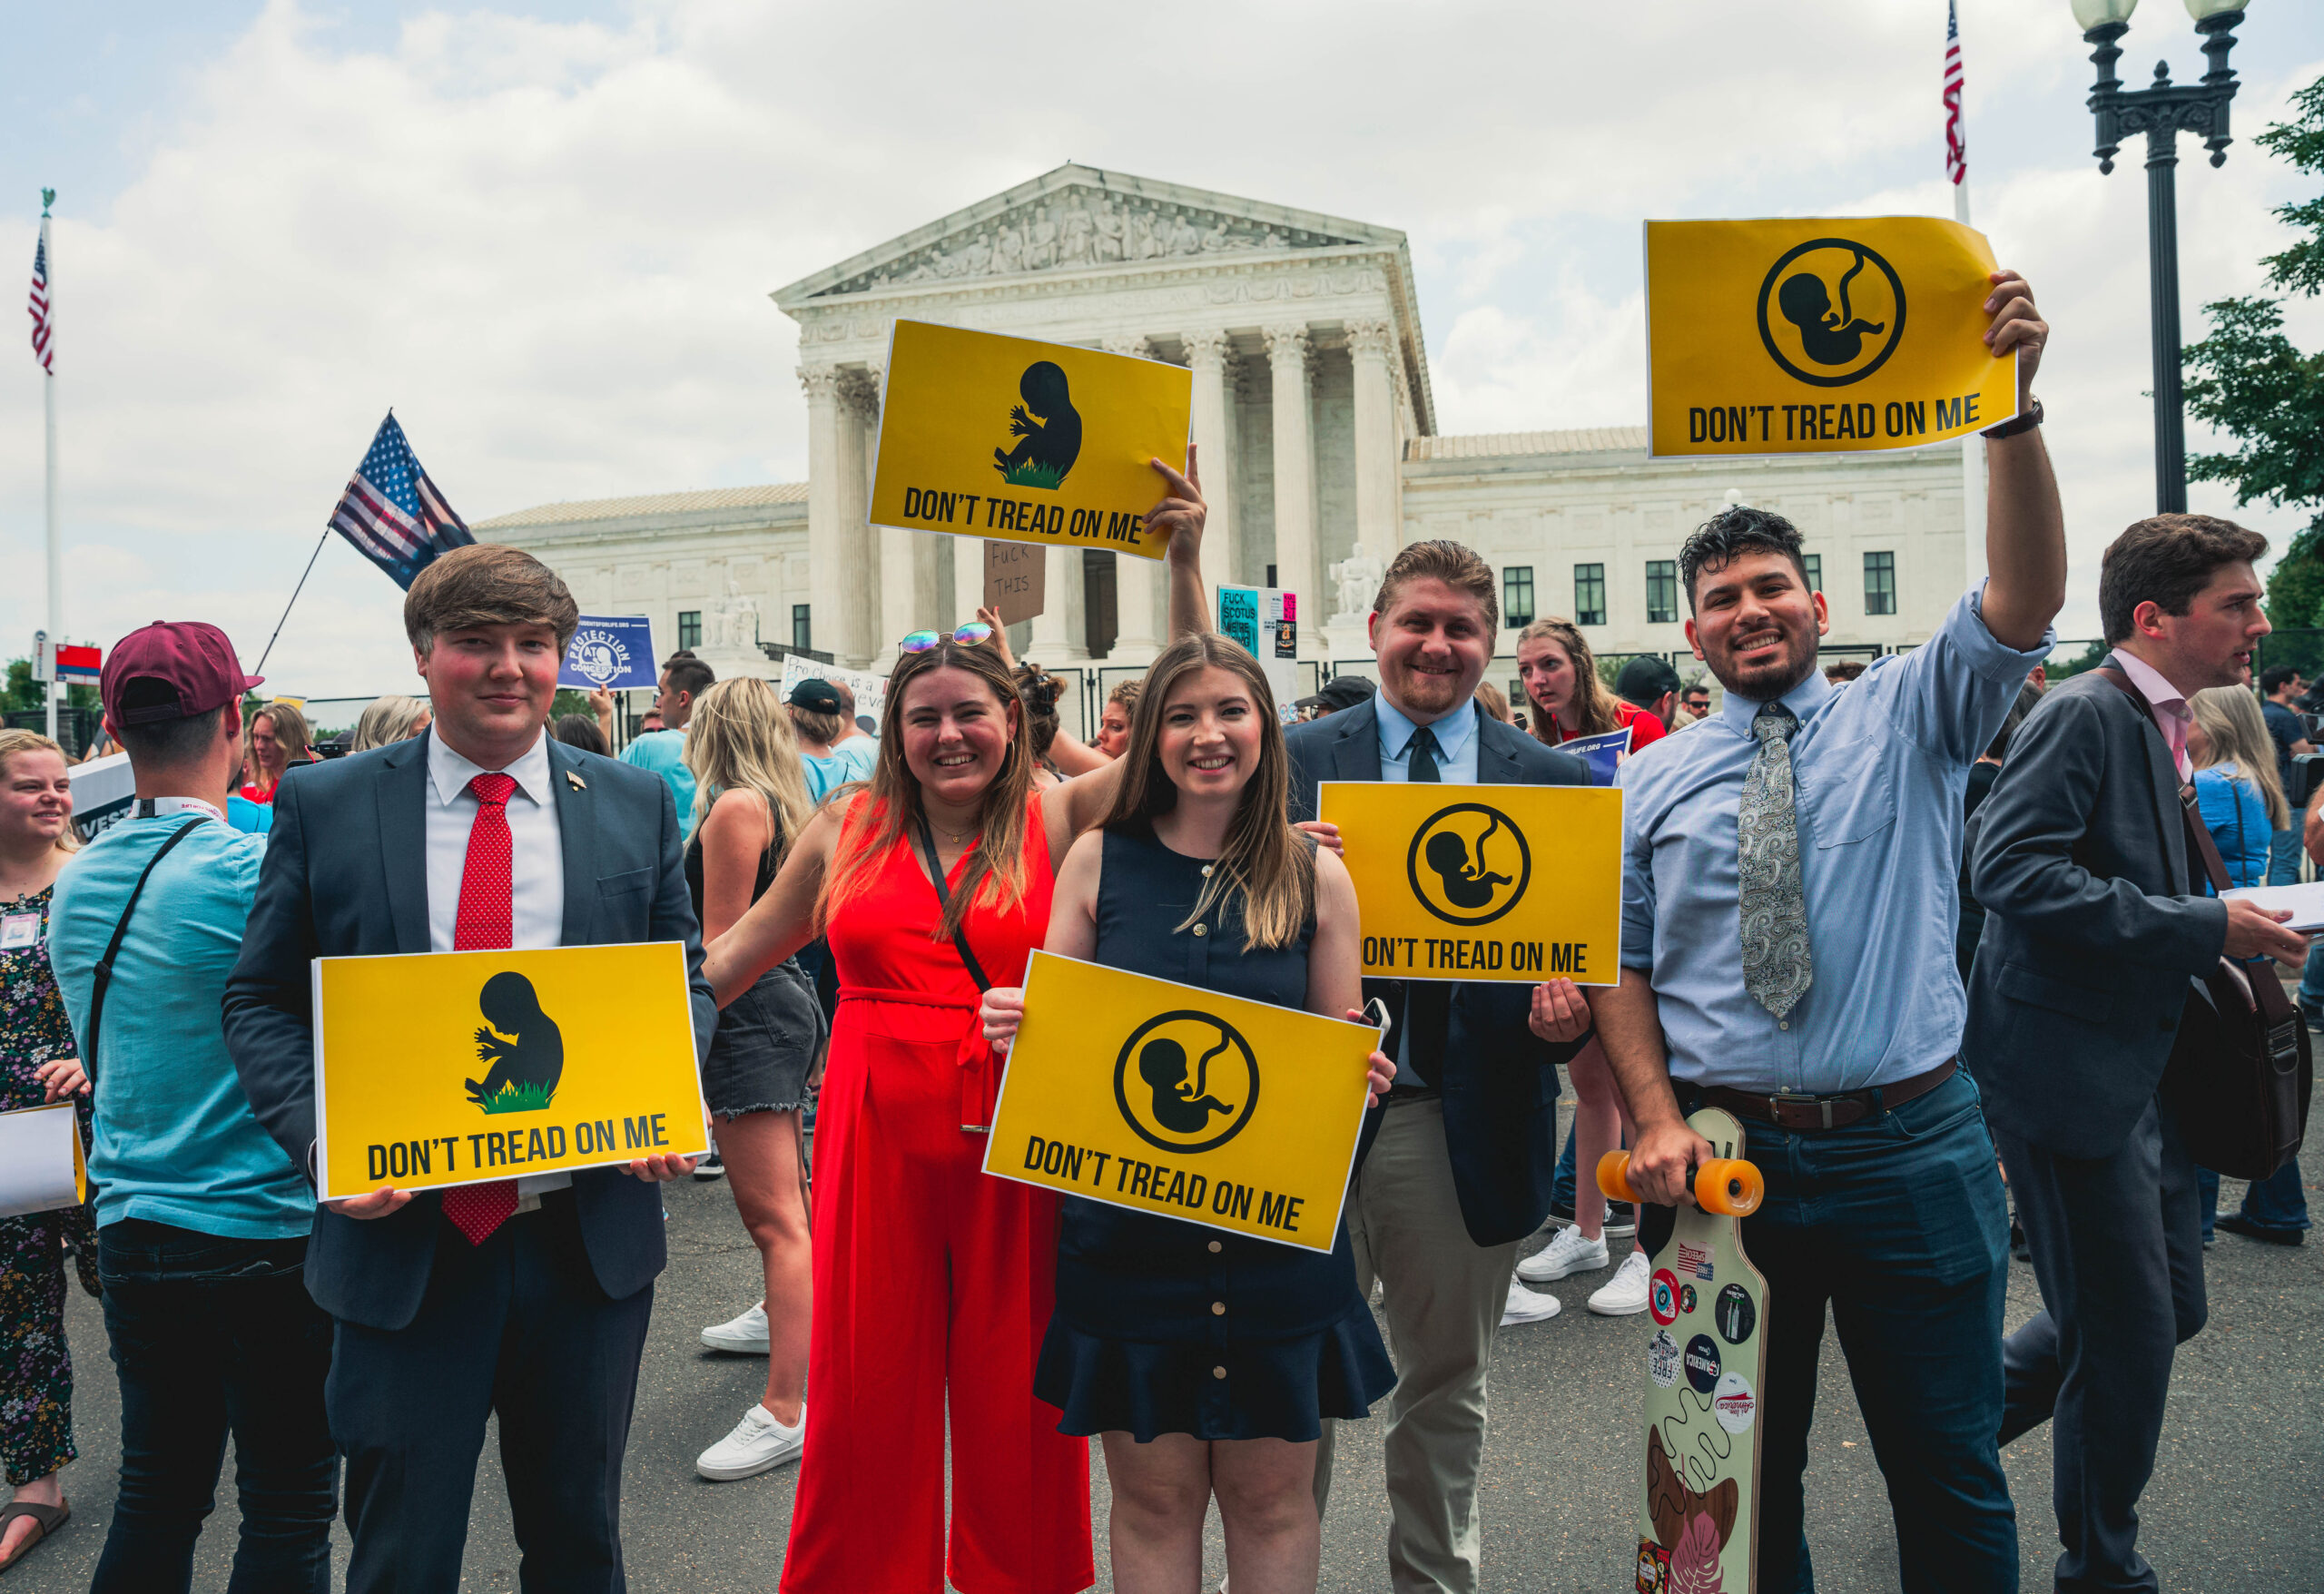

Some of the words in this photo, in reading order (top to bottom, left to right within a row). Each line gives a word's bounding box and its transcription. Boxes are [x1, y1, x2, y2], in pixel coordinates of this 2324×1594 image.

[1689, 405, 1774, 443] DON'T
[1782, 403, 1876, 441] TREAD
[1886, 400, 1925, 438] ON
[1935, 393, 1980, 431] ME
[903, 487, 980, 525] DON'T
[986, 497, 1065, 535] TREAD
[1068, 507, 1103, 537] ON
[1106, 511, 1145, 545] ME
[994, 575, 1029, 596] THIS
[1224, 593, 1246, 605] FUCK
[1223, 607, 1256, 619] SCOTUS
[569, 630, 631, 661] PROTECTION
[584, 645, 597, 657] AT
[570, 664, 632, 674] CONCEPTION
[788, 656, 809, 675] Pro
[851, 675, 862, 689] is
[1360, 936, 1418, 968] ON'T
[1424, 939, 1503, 970] TREAD
[1511, 941, 1542, 972] ON
[1551, 942, 1588, 973] ME
[368, 1136, 459, 1181] DON'T
[467, 1126, 566, 1168] TREAD
[575, 1119, 615, 1155] ON
[623, 1113, 669, 1149] ME
[1023, 1135, 1111, 1186] DON'T
[1117, 1156, 1207, 1209] TREAD
[1212, 1181, 1254, 1220] ON
[1256, 1190, 1305, 1232] ME
[1685, 1249, 1705, 1263] SPEECH
[1698, 1264, 1709, 1274] FREE
[1652, 1357, 1672, 1379] FREE
[1686, 1353, 1711, 1373] AMERICA
